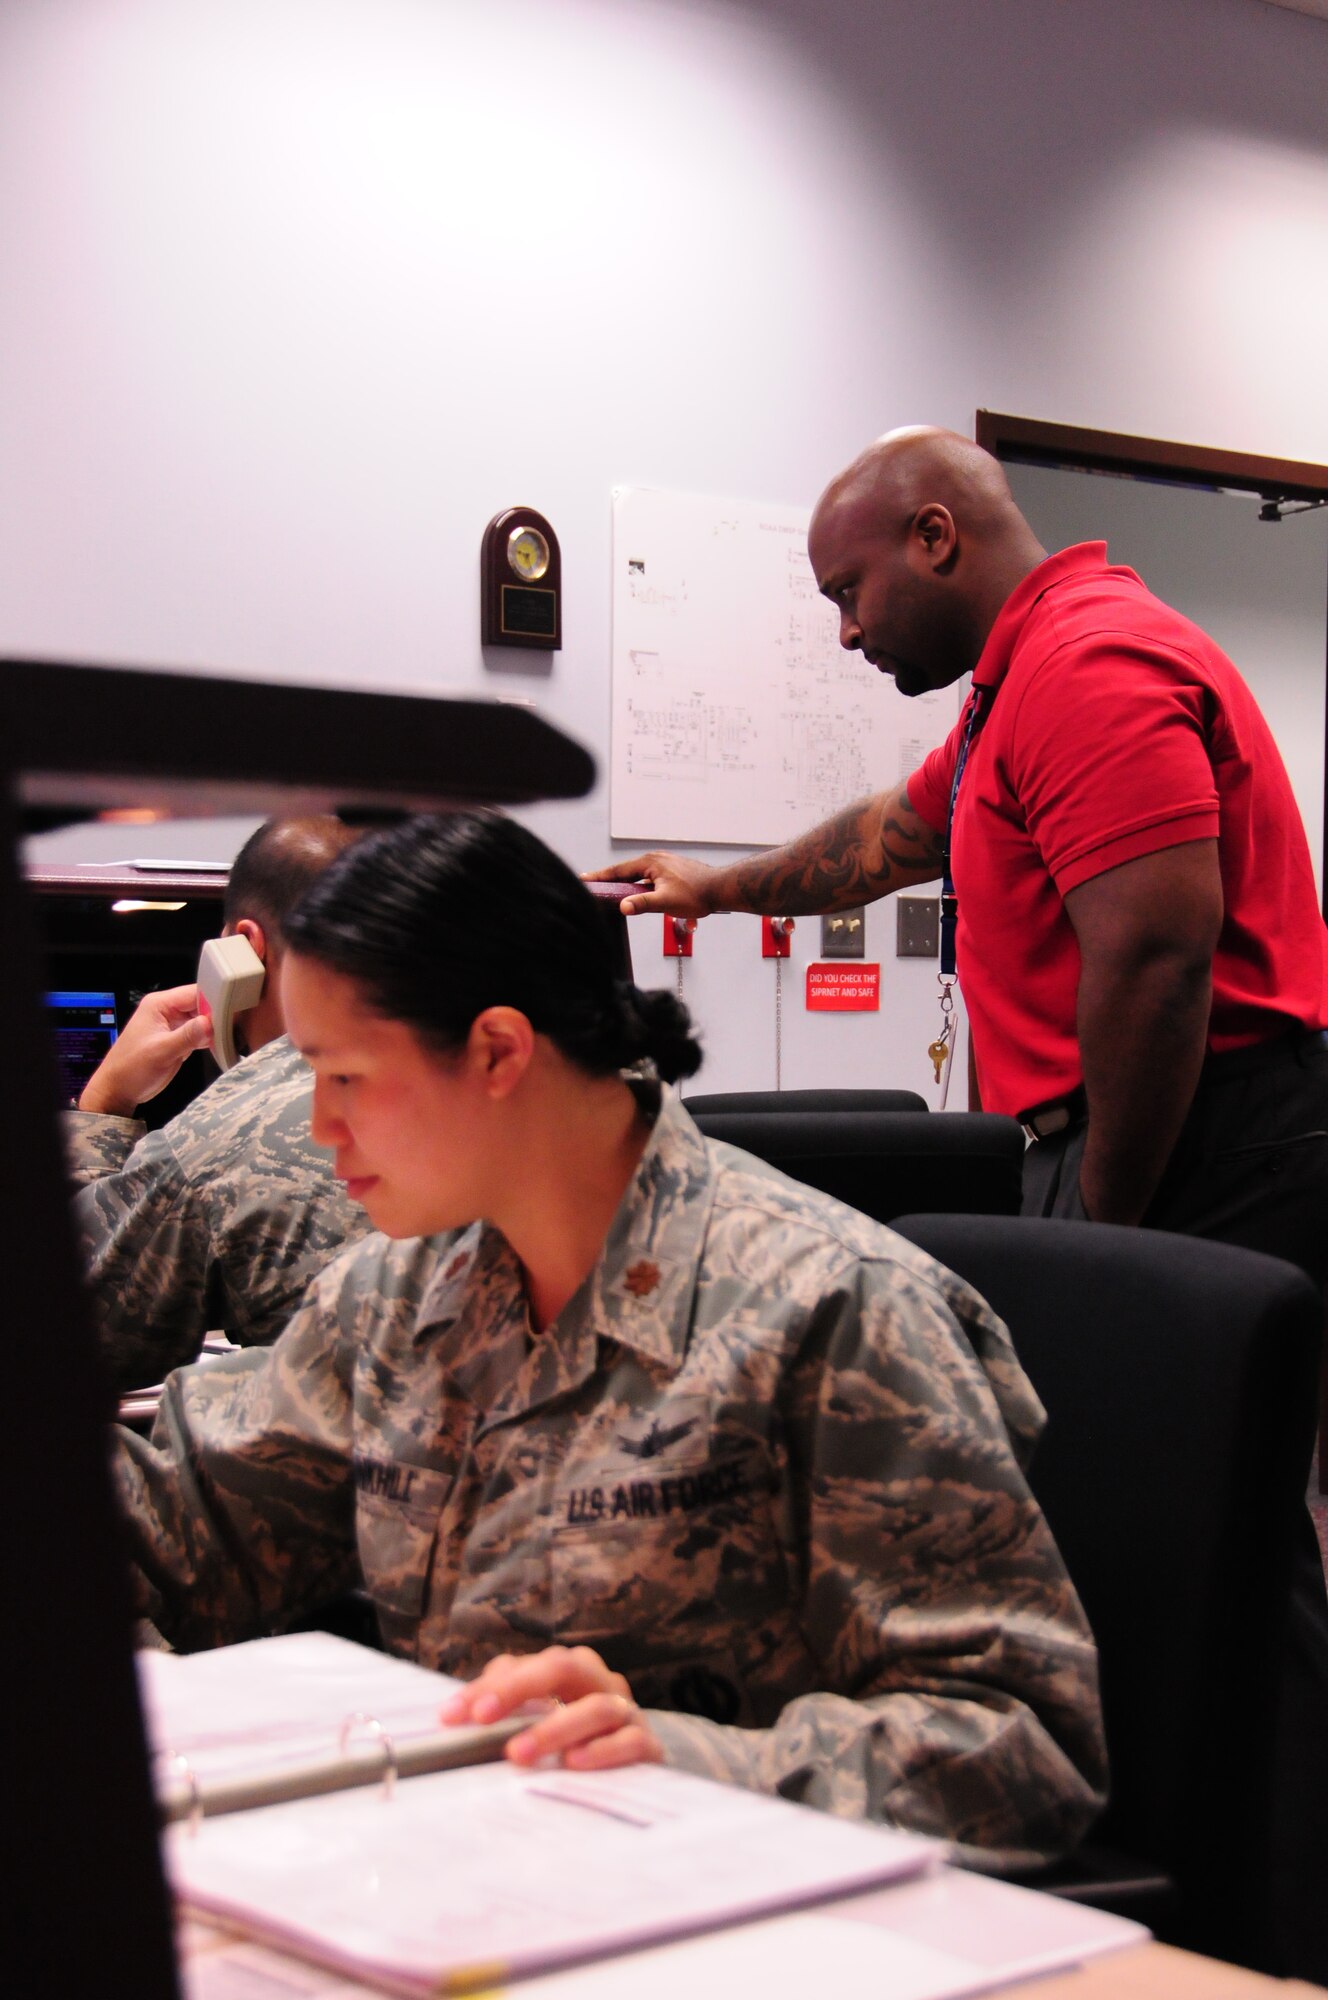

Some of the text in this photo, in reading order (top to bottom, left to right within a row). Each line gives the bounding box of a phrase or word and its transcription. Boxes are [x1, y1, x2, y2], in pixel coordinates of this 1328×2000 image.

[809, 973, 877, 983] DID YOU CHECK THE
[811, 987, 874, 997] SIPRNET AND SAFE
[612, 1479, 657, 1519] AIR
[661, 1460, 747, 1513] FORCE
